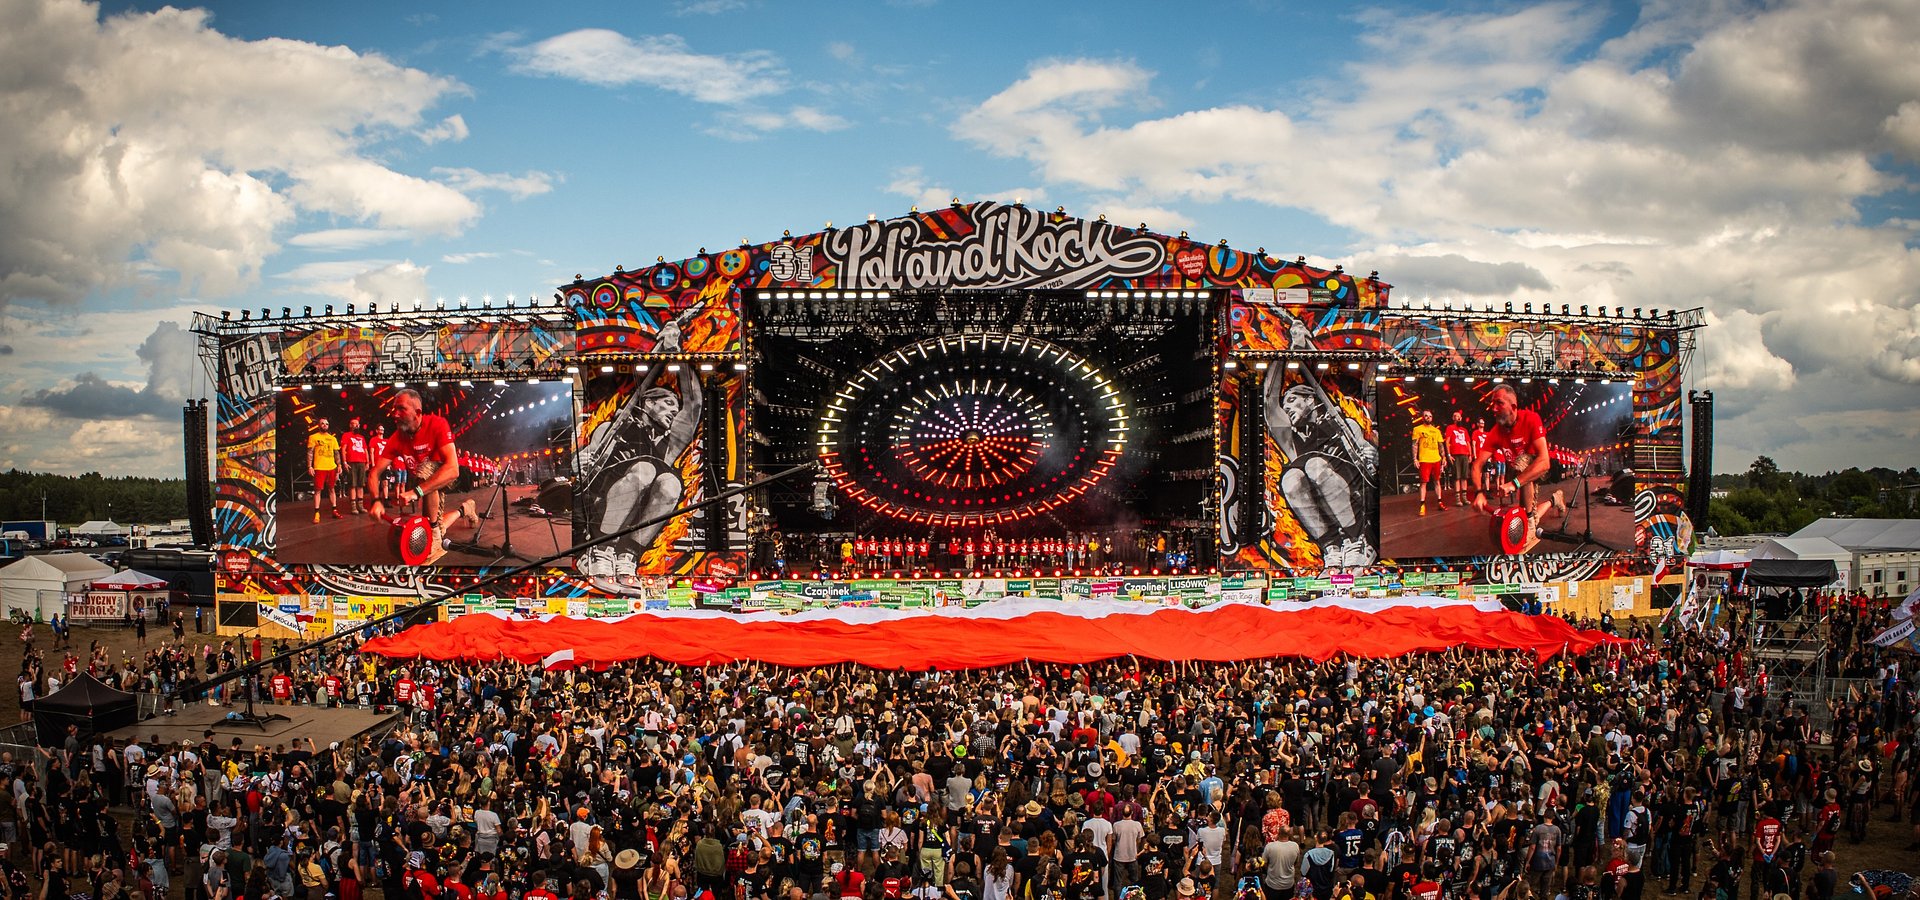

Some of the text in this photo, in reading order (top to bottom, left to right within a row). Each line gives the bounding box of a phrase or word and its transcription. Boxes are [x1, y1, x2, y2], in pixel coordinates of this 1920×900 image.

[771, 245, 814, 282] 31
[225, 335, 279, 375] POL
[381, 331, 438, 372] 31
[1506, 329, 1555, 370] 31
[755, 582, 781, 591] Sosnowiec
[1073, 585, 1089, 594] Piła
[1124, 583, 1167, 592] Czaplinek
[1170, 579, 1208, 589] LUSÓWKO
[804, 586, 850, 598] Czaplinek
[73, 606, 107, 616] PATROL
[1345, 840, 1361, 857] 15
